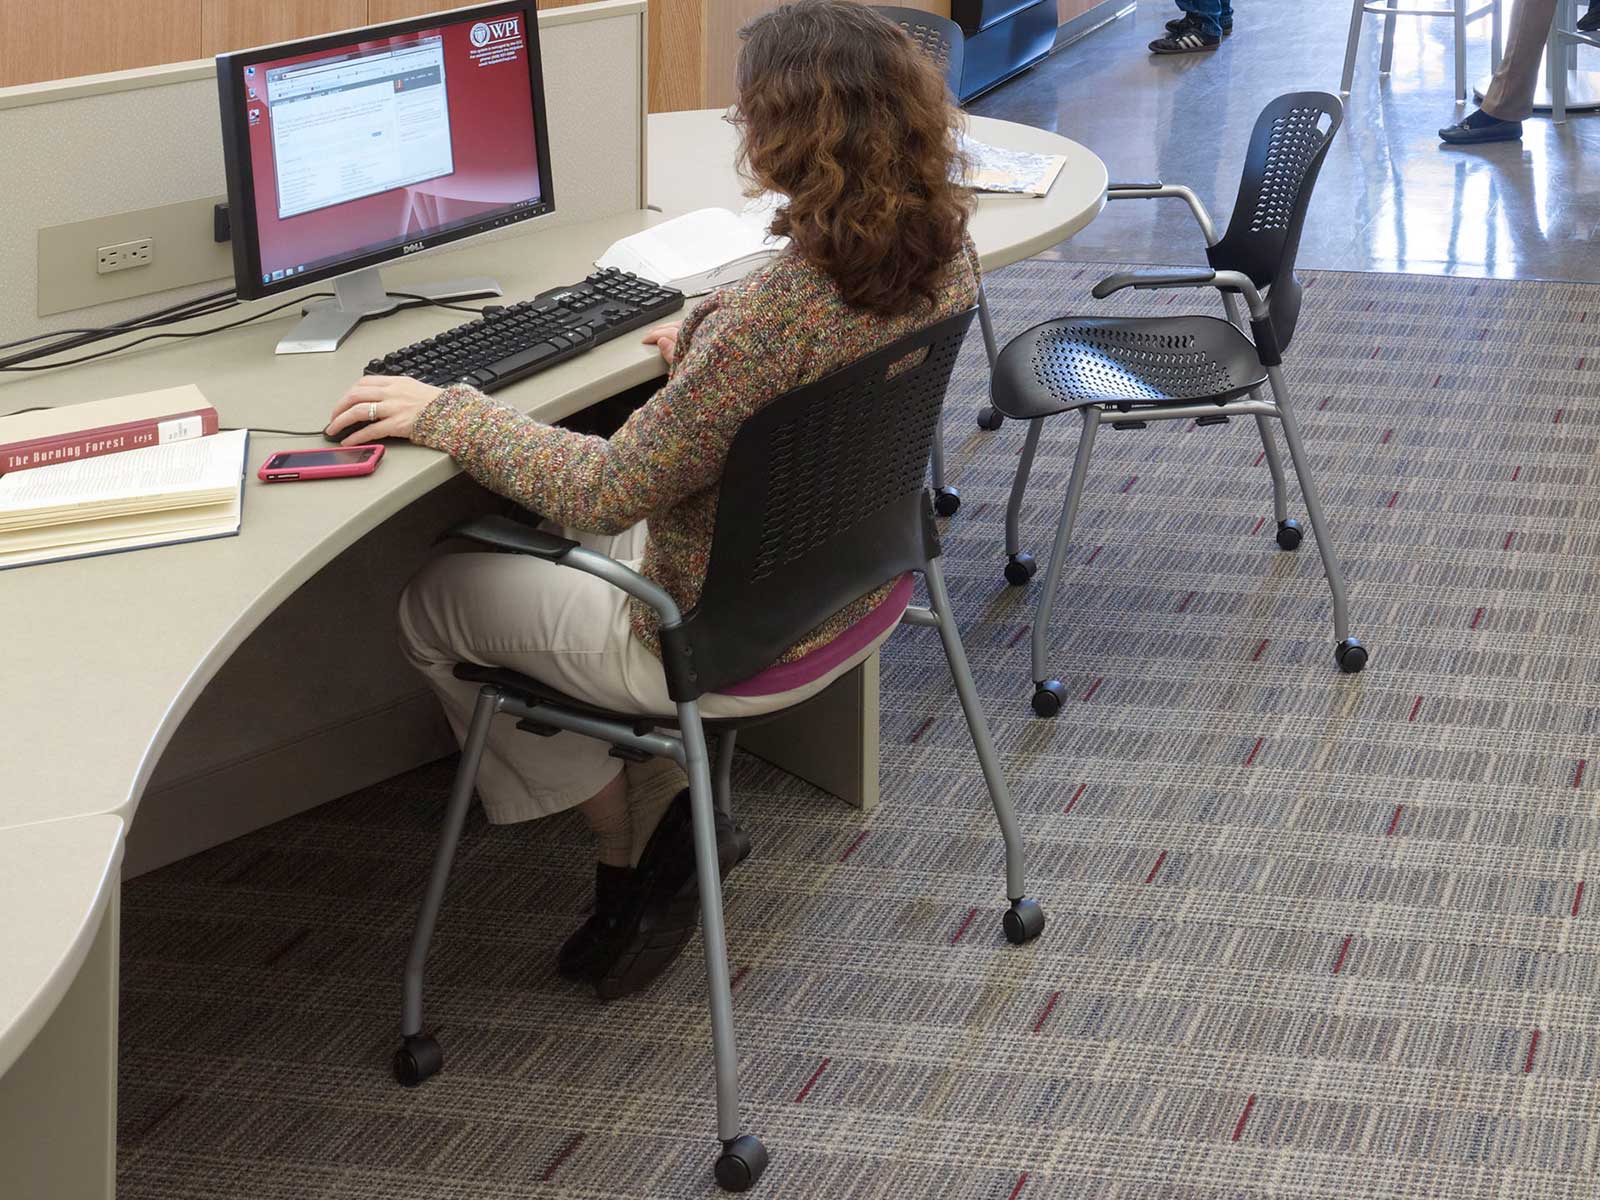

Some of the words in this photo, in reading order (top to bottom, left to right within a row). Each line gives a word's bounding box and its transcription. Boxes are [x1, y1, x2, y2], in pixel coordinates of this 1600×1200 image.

[489, 19, 520, 39] WPI
[403, 241, 425, 254] DELL
[552, 291, 572, 301] DELL
[9, 455, 29, 467] The
[33, 445, 81, 464] Burning
[85, 436, 125, 453] Forest
